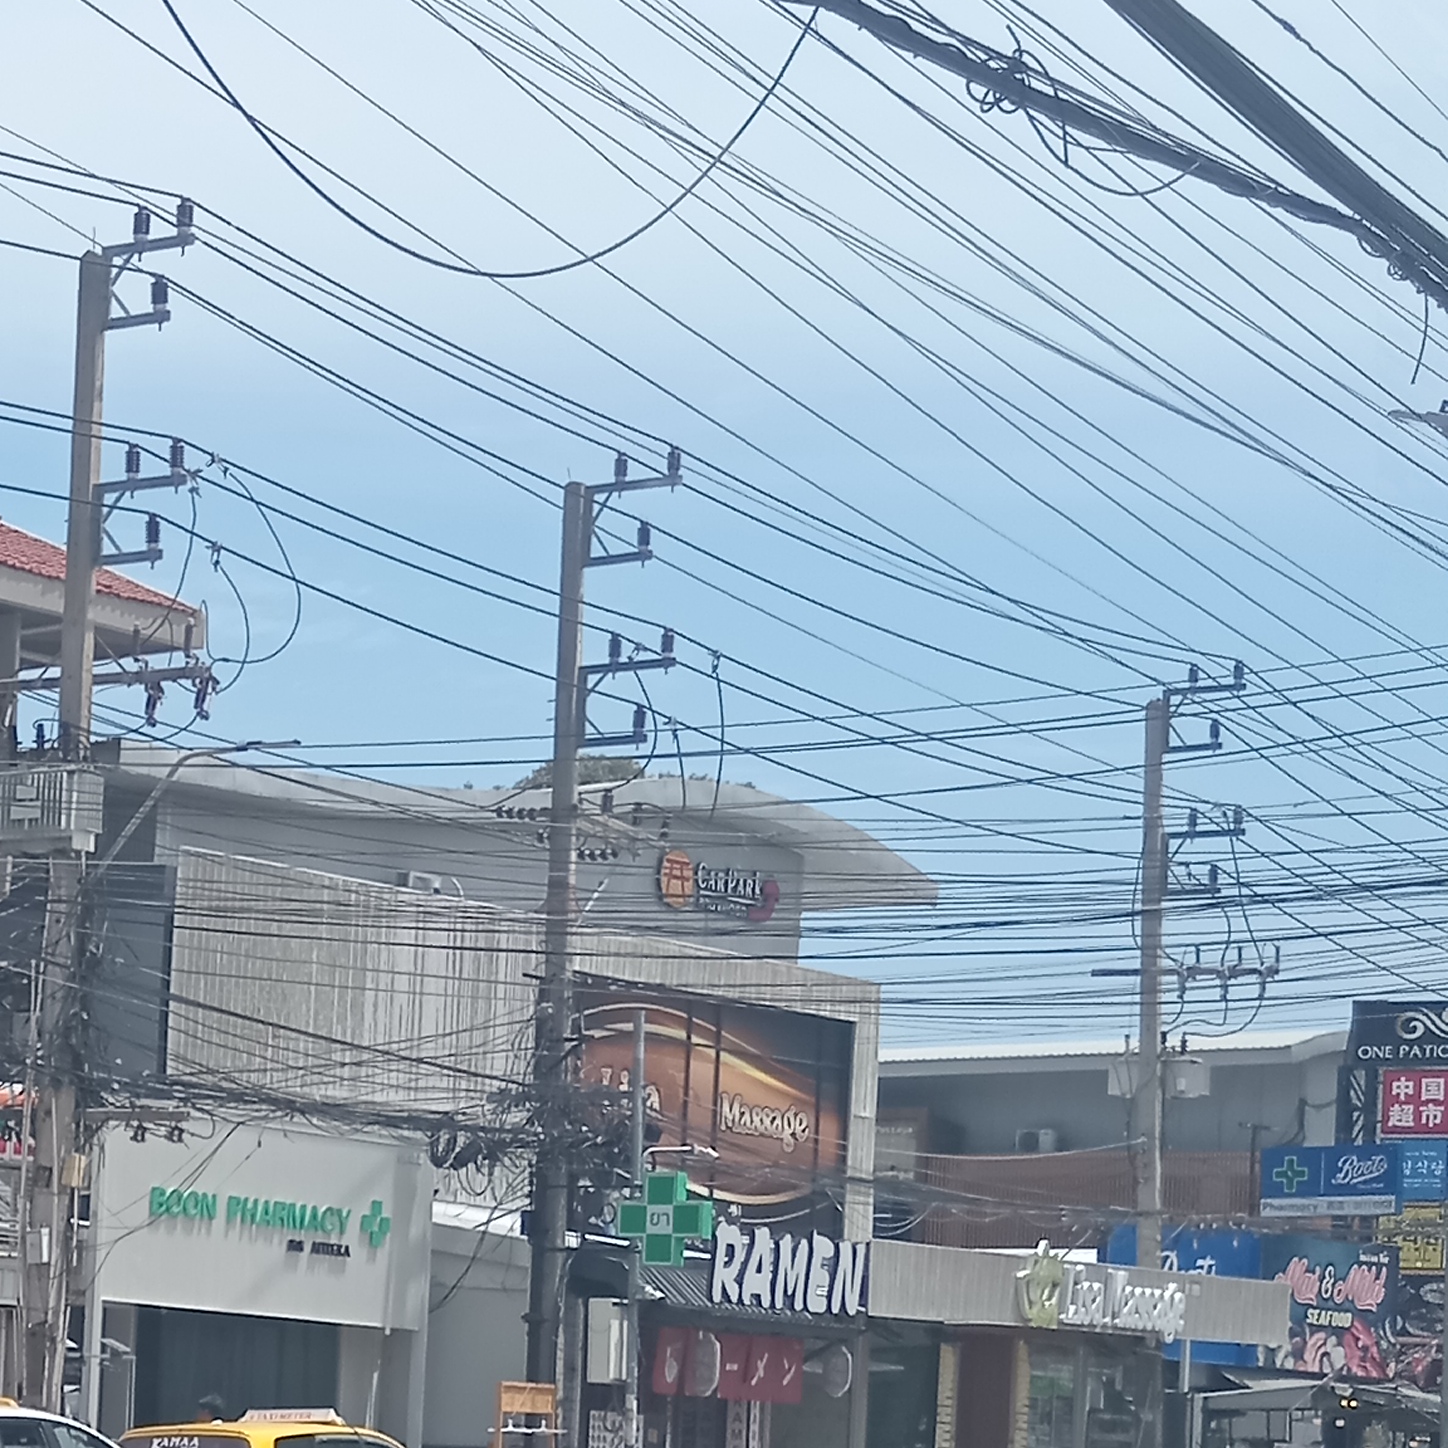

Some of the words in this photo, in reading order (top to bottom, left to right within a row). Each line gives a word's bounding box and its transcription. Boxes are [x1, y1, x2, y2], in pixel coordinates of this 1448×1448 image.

[1357, 1045, 1394, 1060] ONE
[1391, 1076, 1446, 1102] 中国
[719, 1092, 810, 1153] Massage
[1387, 1103, 1446, 1129] 超市
[1331, 1155, 1388, 1185] Boots
[149, 1186, 218, 1222] BOON
[226, 1194, 352, 1236] PHARMACY
[649, 1211, 671, 1227] ยา
[711, 1221, 866, 1317] RAMEN
[1305, 1308, 1353, 1329] SEAFOOD
